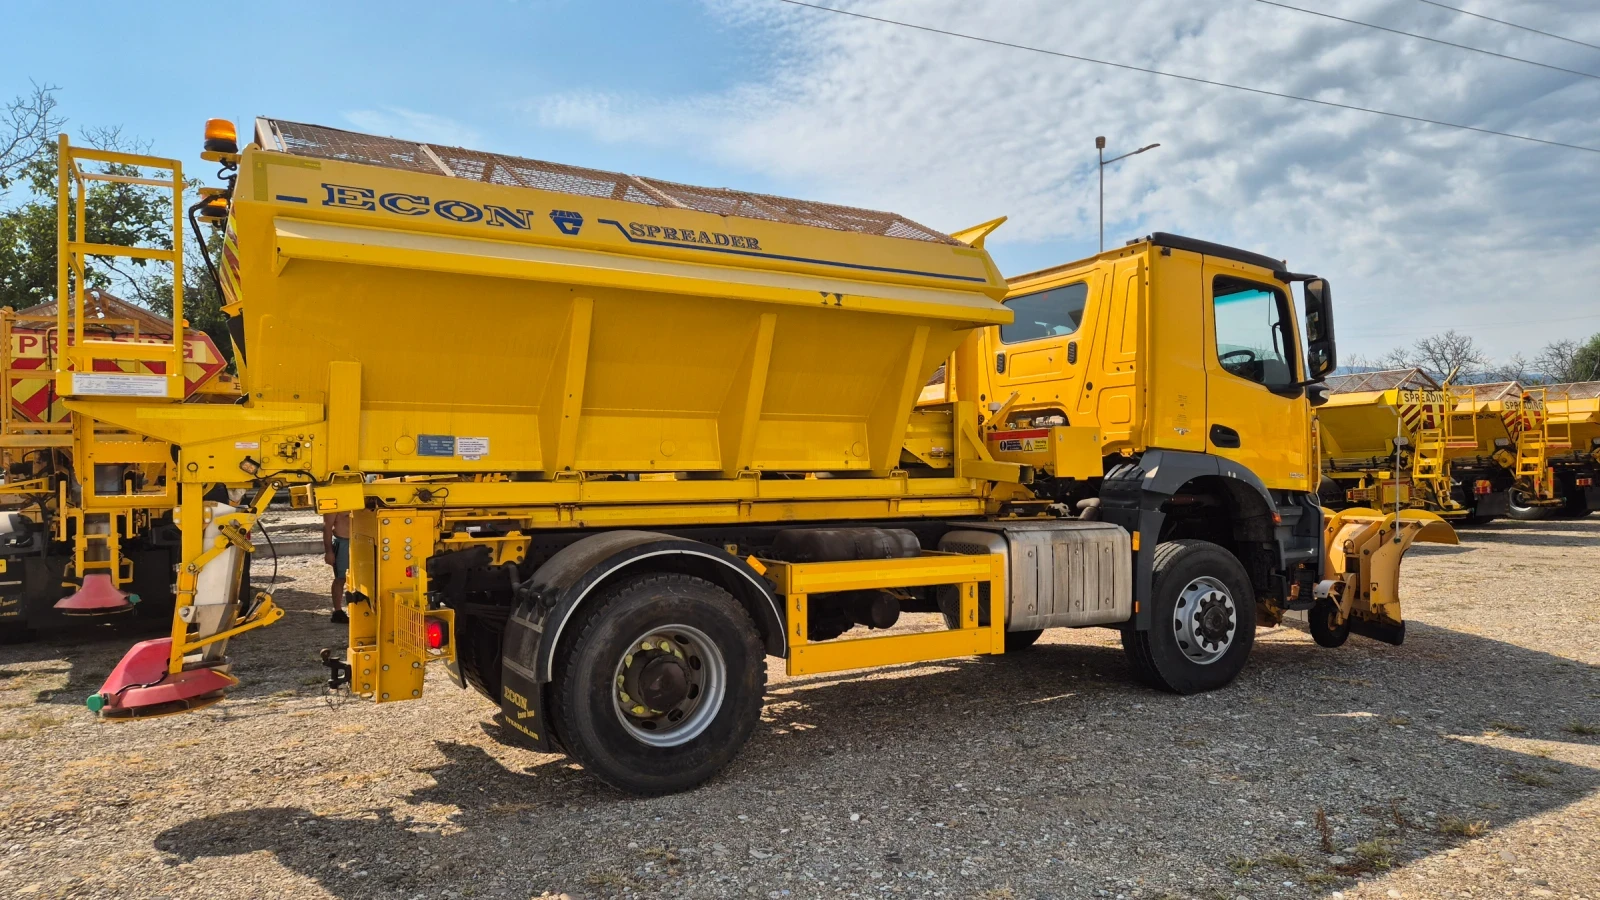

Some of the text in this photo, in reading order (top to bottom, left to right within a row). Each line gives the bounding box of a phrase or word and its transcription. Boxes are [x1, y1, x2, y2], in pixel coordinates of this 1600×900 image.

[321, 182, 533, 230] ECON
[629, 221, 762, 251] SPREADER
[1504, 400, 1544, 410] SPRADING
[504, 685, 528, 710] ECON
